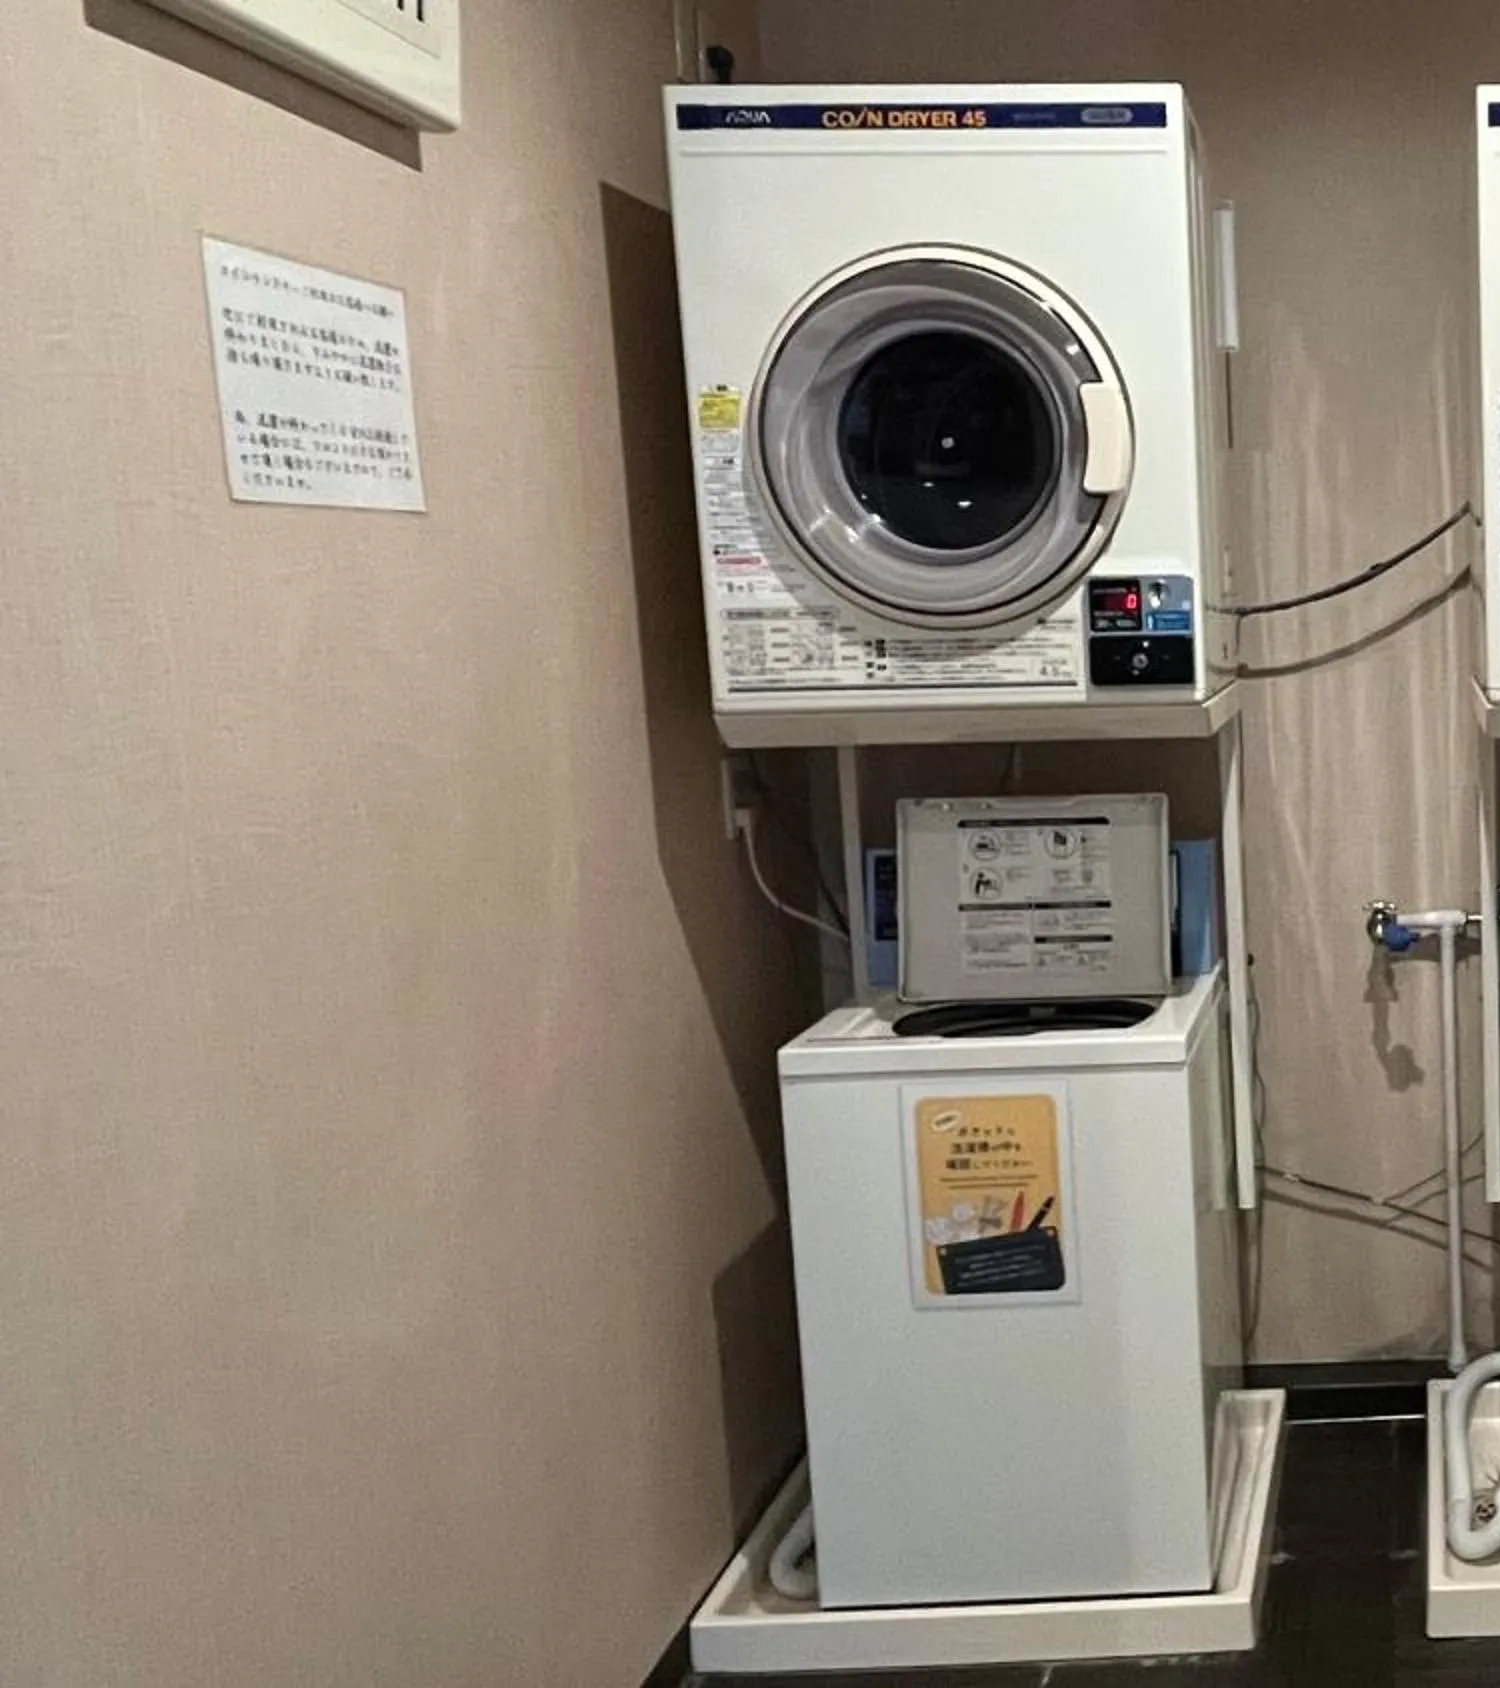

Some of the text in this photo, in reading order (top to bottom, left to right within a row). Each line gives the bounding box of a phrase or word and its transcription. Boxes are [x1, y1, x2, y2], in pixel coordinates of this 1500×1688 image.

[888, 111, 957, 127] DRYER
[962, 111, 987, 127] 45
[1126, 593, 1137, 609] 0
